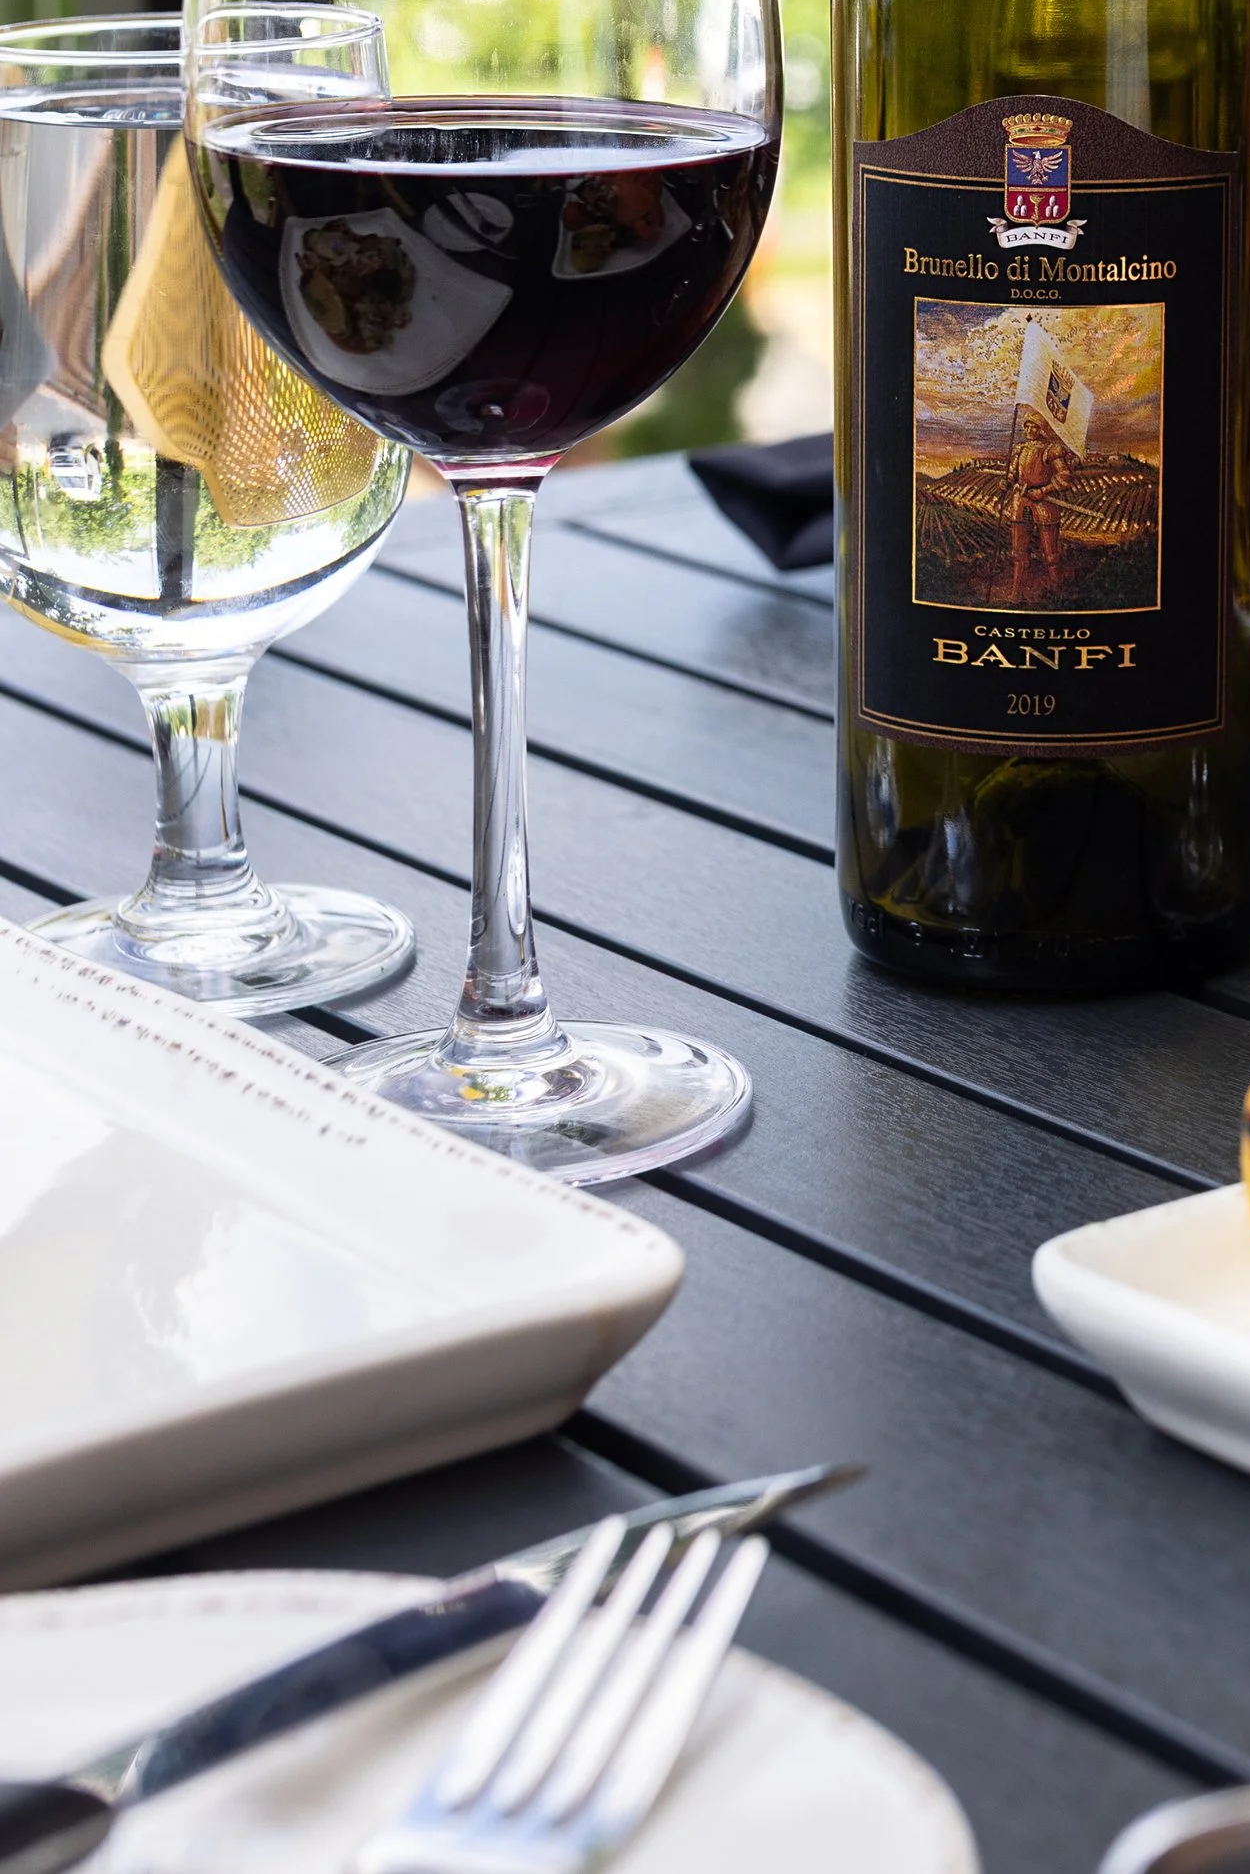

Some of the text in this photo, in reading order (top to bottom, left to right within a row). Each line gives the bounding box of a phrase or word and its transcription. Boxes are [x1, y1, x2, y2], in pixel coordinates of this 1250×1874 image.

[1005, 231, 1069, 244] BANFI
[903, 247, 1177, 283] Brunello di Montalcino
[1010, 288, 1062, 300] D.O.C.G.
[974, 626, 1091, 639] CASTELLO
[932, 637, 1137, 670] BANFI
[1006, 693, 1056, 716] 2019
